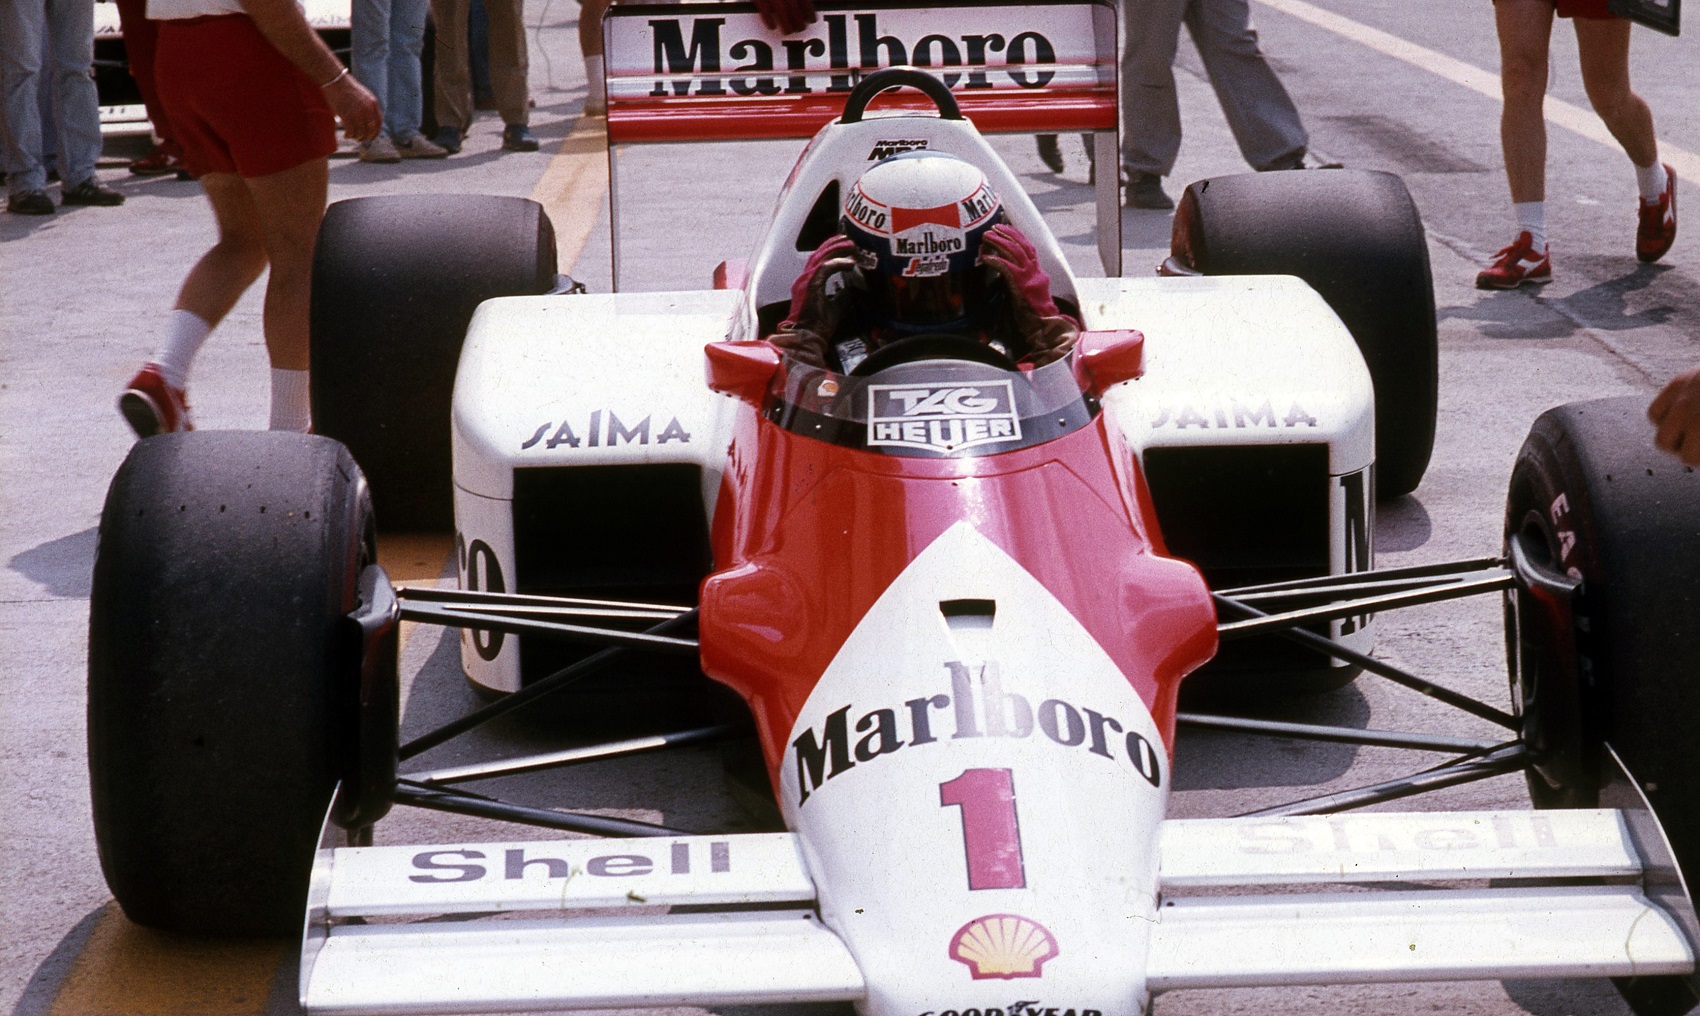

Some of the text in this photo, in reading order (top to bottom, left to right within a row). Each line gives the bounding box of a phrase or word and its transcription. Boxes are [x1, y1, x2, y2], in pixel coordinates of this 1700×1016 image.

[648, 13, 1057, 97] Marlboro
[896, 231, 961, 254] Marlboro
[889, 387, 999, 416] TAG
[521, 409, 691, 450] SAIMA
[876, 419, 1012, 445] HEUER
[792, 660, 1161, 808] Marlboro
[939, 768, 1027, 891] 1
[408, 841, 731, 883] Shell
